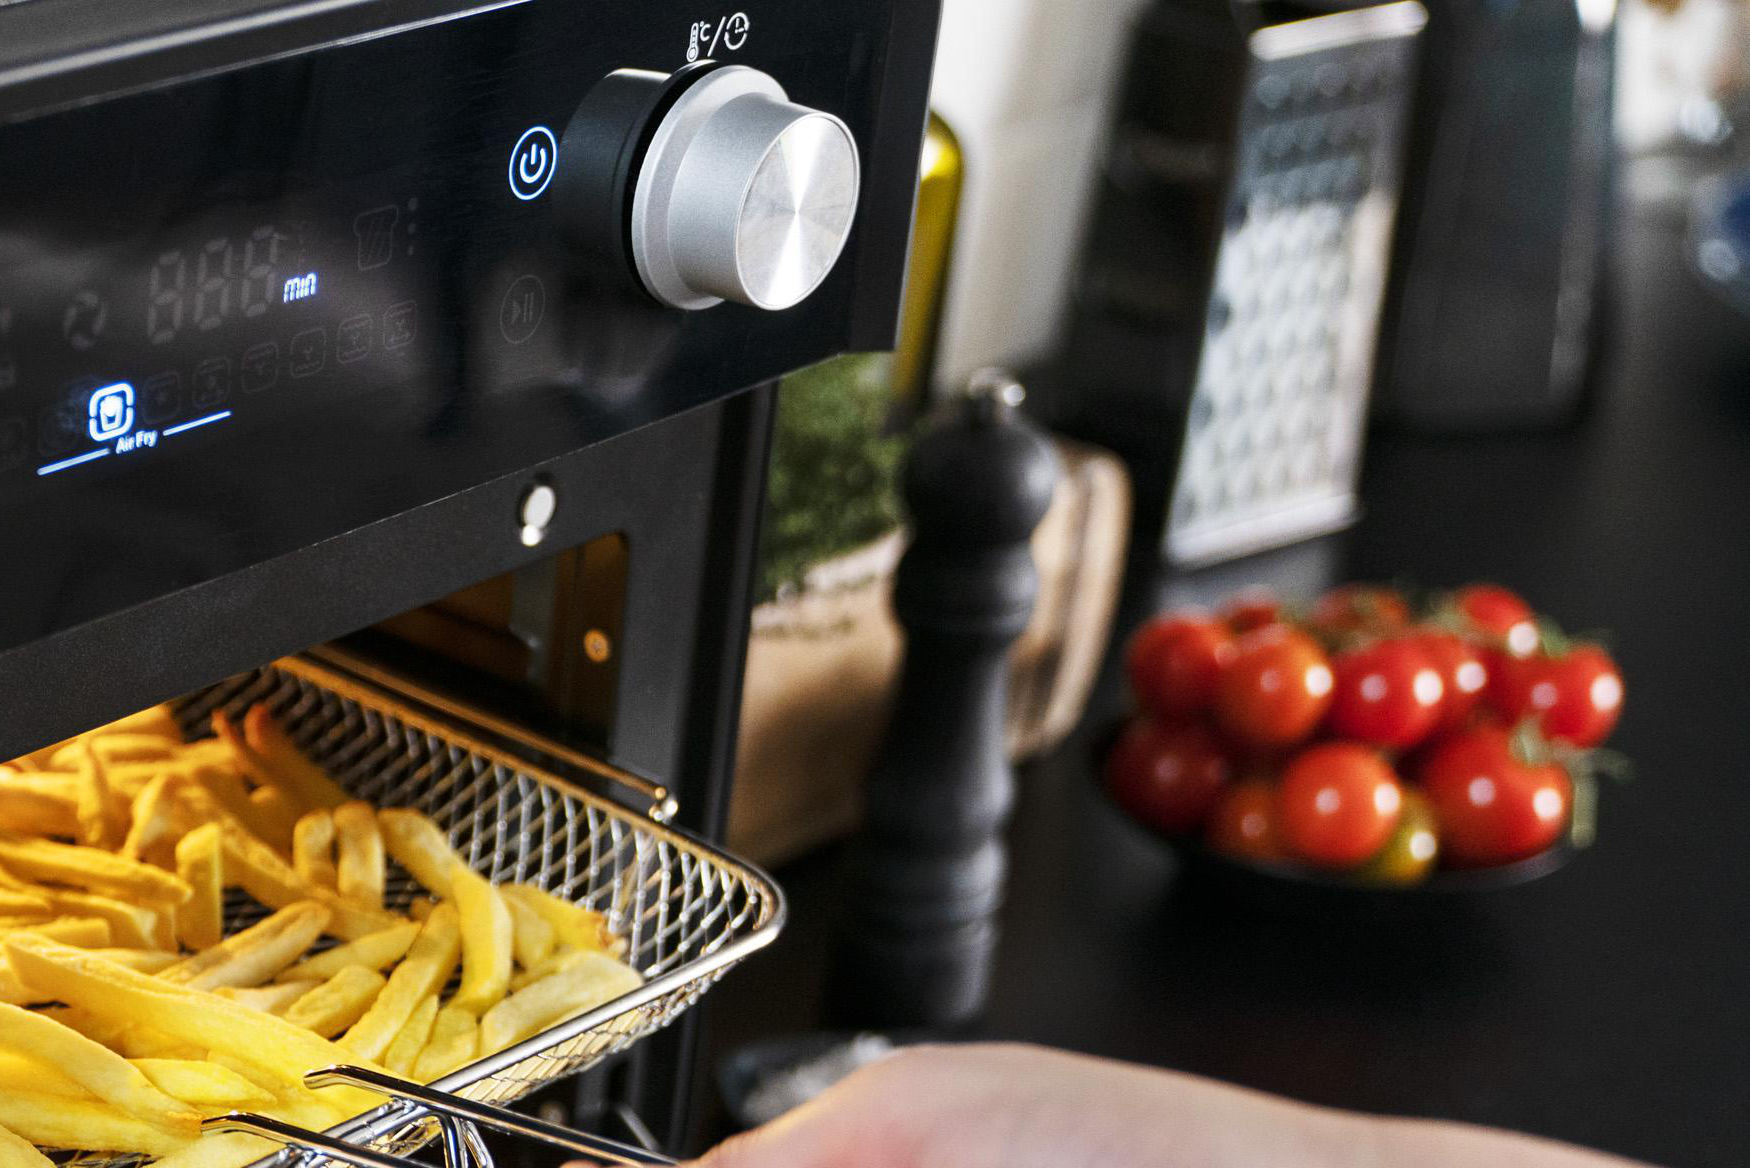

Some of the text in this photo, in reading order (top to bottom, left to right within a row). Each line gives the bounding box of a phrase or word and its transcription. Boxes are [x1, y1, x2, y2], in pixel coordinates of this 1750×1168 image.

[283, 272, 318, 303] min
[116, 431, 157, 453] Air Fry
